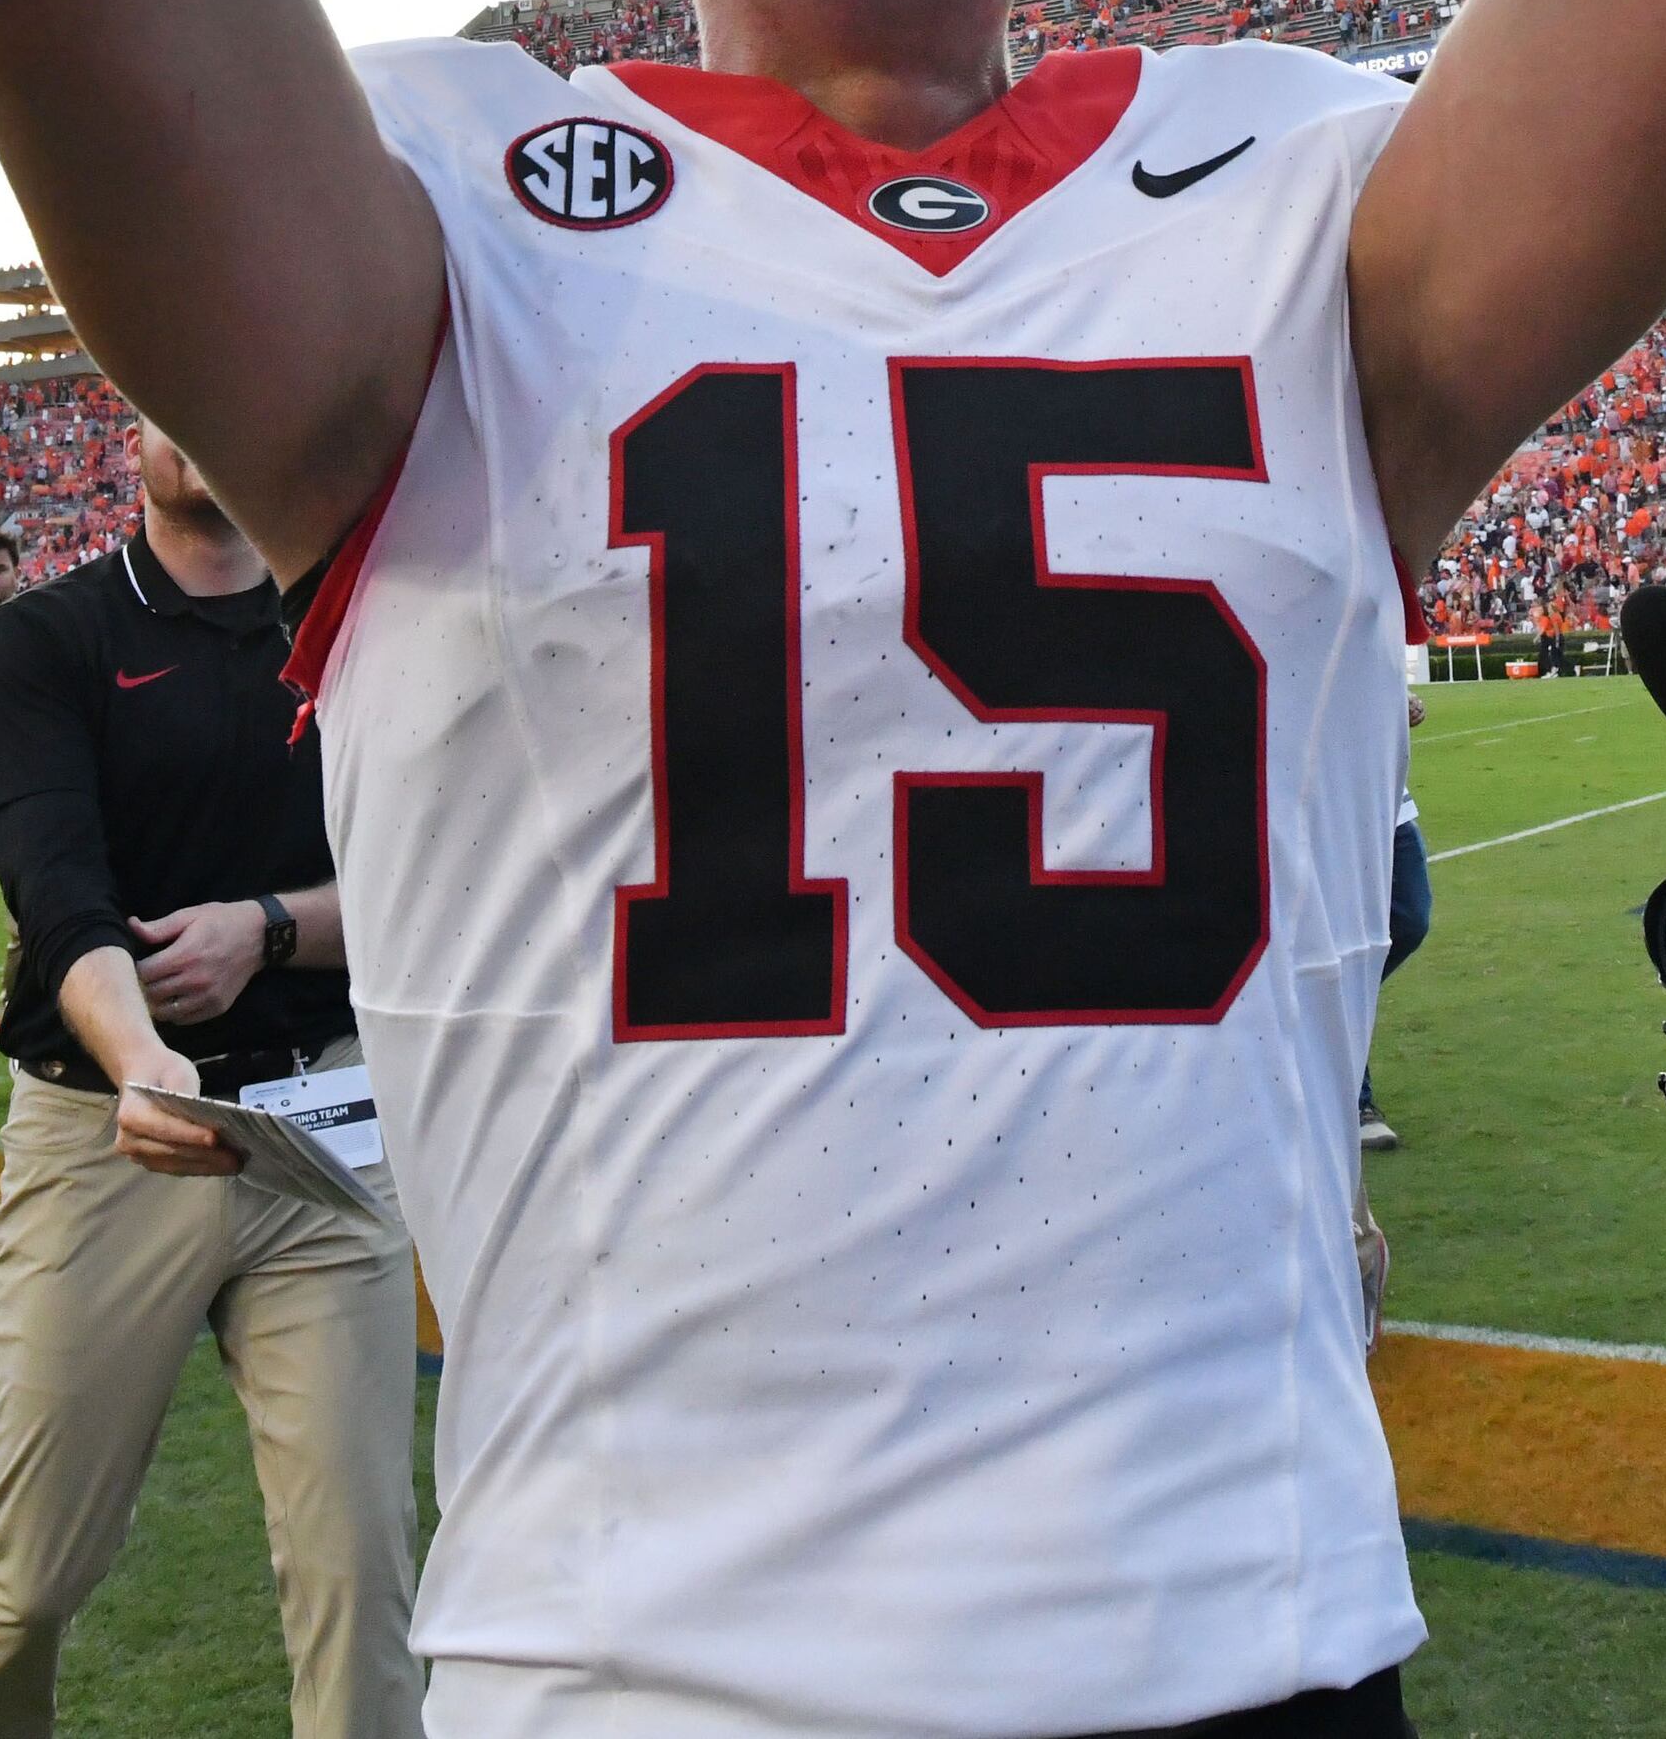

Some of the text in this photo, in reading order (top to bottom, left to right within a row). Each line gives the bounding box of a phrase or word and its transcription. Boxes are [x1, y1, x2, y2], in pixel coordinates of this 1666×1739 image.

[1408, 50, 1429, 66] TO
[520, 123, 657, 219] SEC
[898, 186, 985, 221] G
[608, 355, 1269, 1044] 15
[318, 1105, 349, 1120] TEAM
